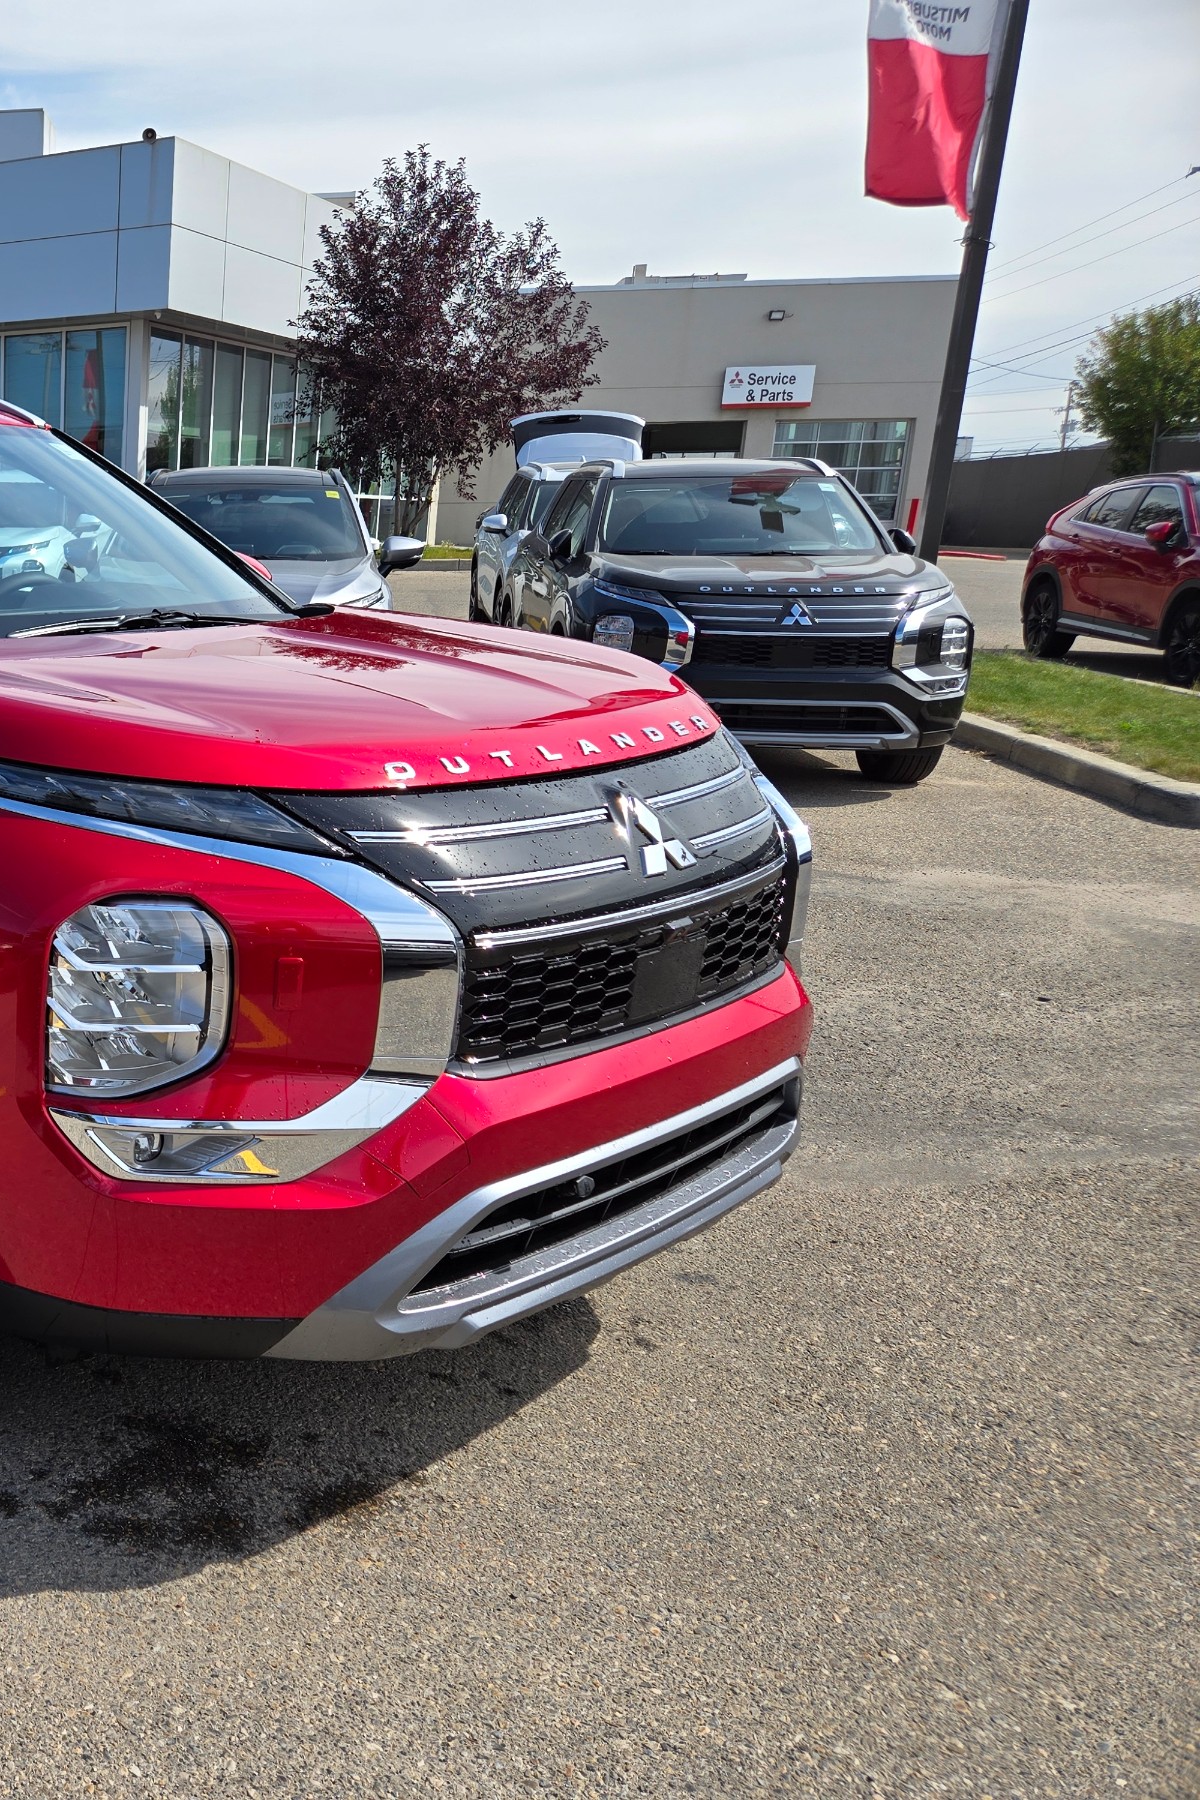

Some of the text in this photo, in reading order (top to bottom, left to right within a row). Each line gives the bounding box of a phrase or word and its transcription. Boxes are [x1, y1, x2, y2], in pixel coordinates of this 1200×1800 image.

[747, 372, 796, 385] Service
[745, 388, 794, 402] & Parts
[699, 586, 886, 594] OUTLANDER
[383, 715, 709, 781] OUTLANDER
